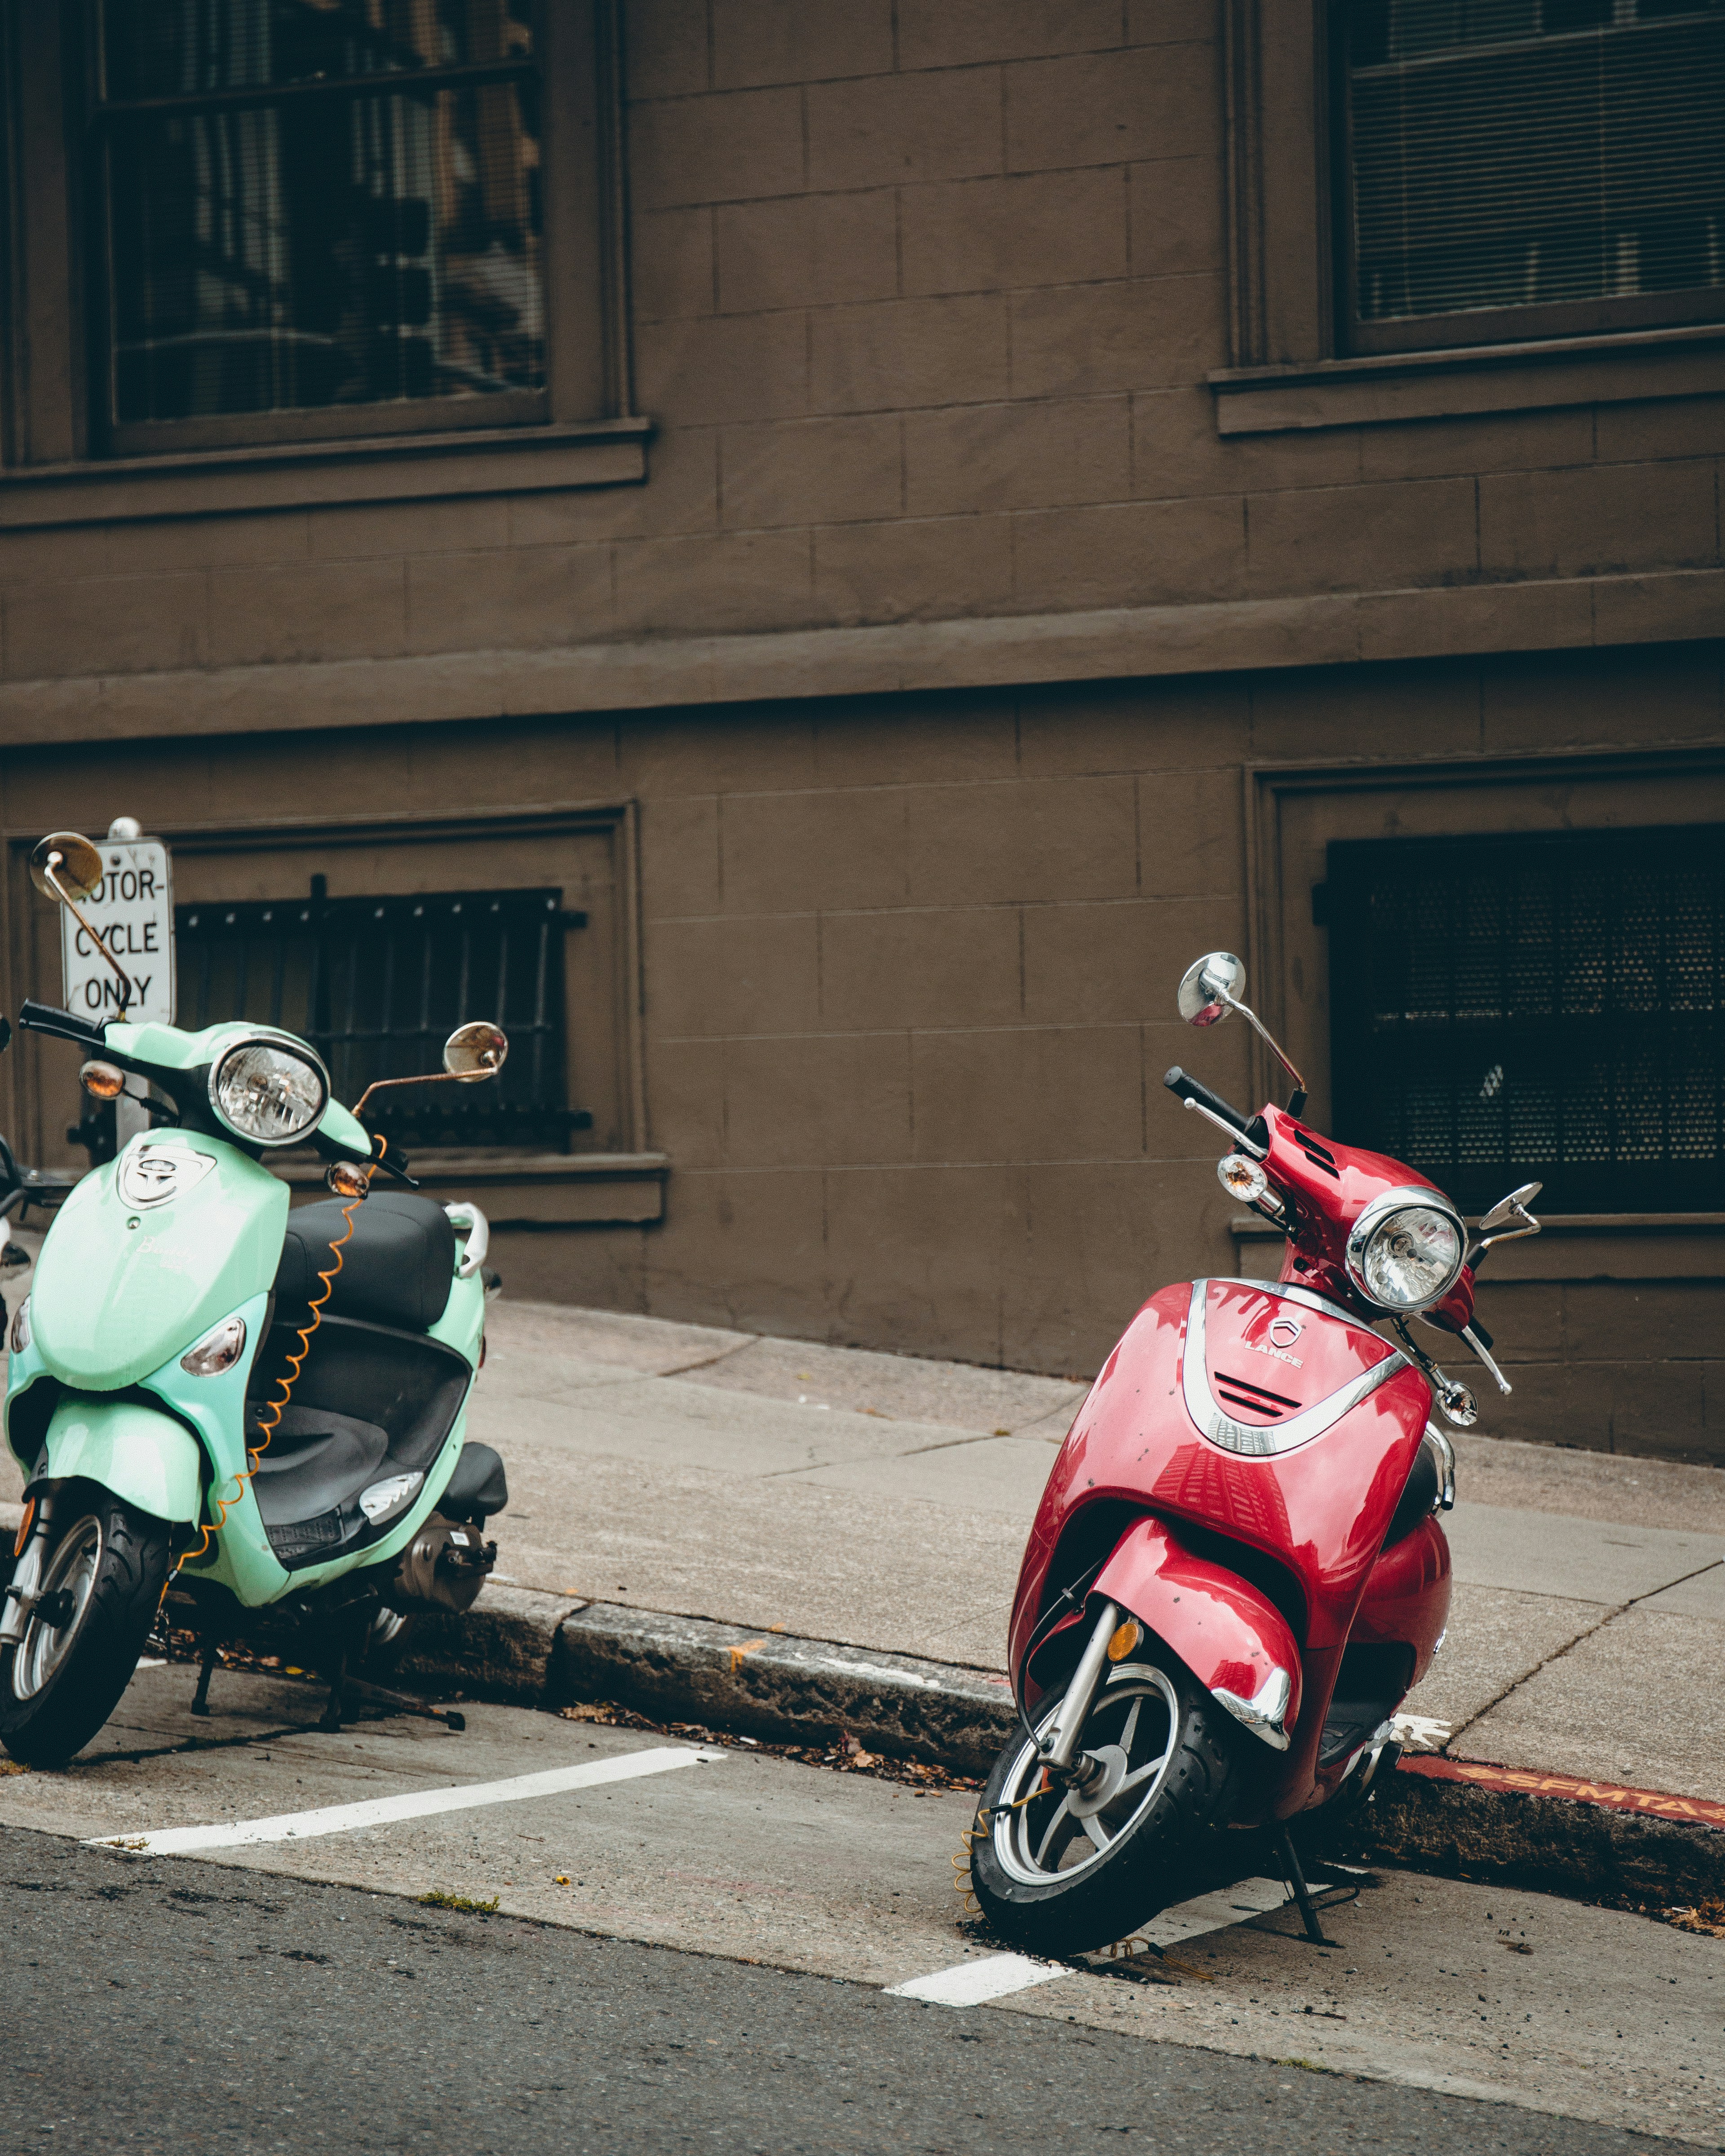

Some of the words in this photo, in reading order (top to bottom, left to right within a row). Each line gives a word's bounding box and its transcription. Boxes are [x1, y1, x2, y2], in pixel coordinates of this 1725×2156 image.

[83, 870, 164, 904] OTOR-
[75, 923, 159, 957] CYCLE
[1244, 1341, 1304, 1369] LANCE
[1502, 1773, 1698, 1816] SFMTA
